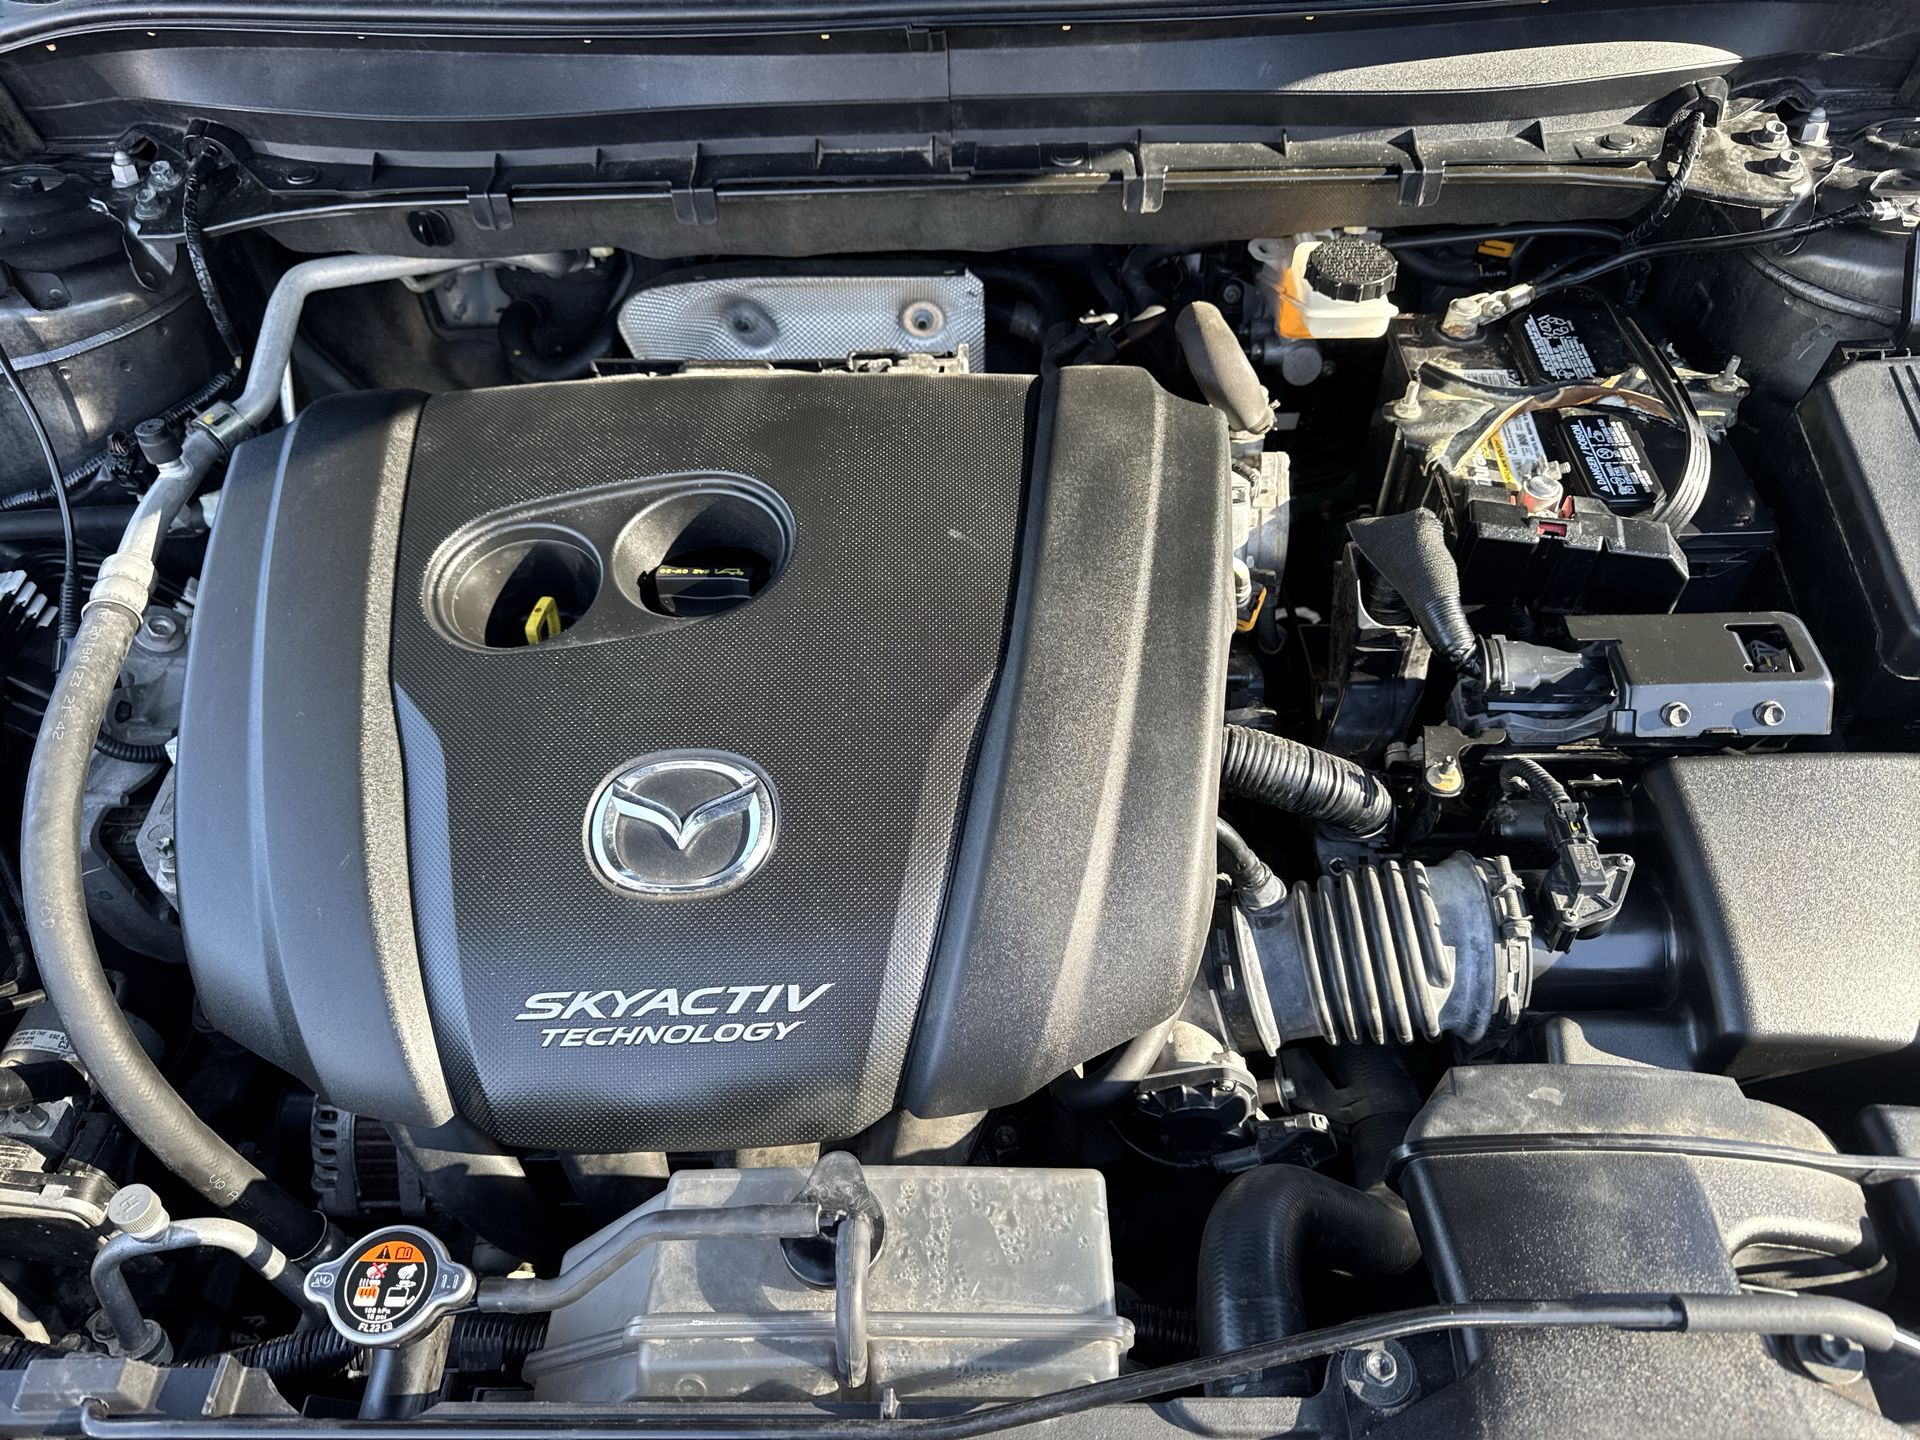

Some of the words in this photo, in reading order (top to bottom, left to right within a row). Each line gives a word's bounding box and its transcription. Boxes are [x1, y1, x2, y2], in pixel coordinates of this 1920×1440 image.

[1570, 424, 1591, 450] POISON
[1585, 456, 1608, 486] DANGER
[52, 694, 76, 740] 21:42
[514, 982, 836, 1021] SKYACTIV
[540, 1020, 807, 1048] TECHNOLOGY
[357, 1321, 381, 1333] FL22
[375, 1313, 387, 1321] psi
